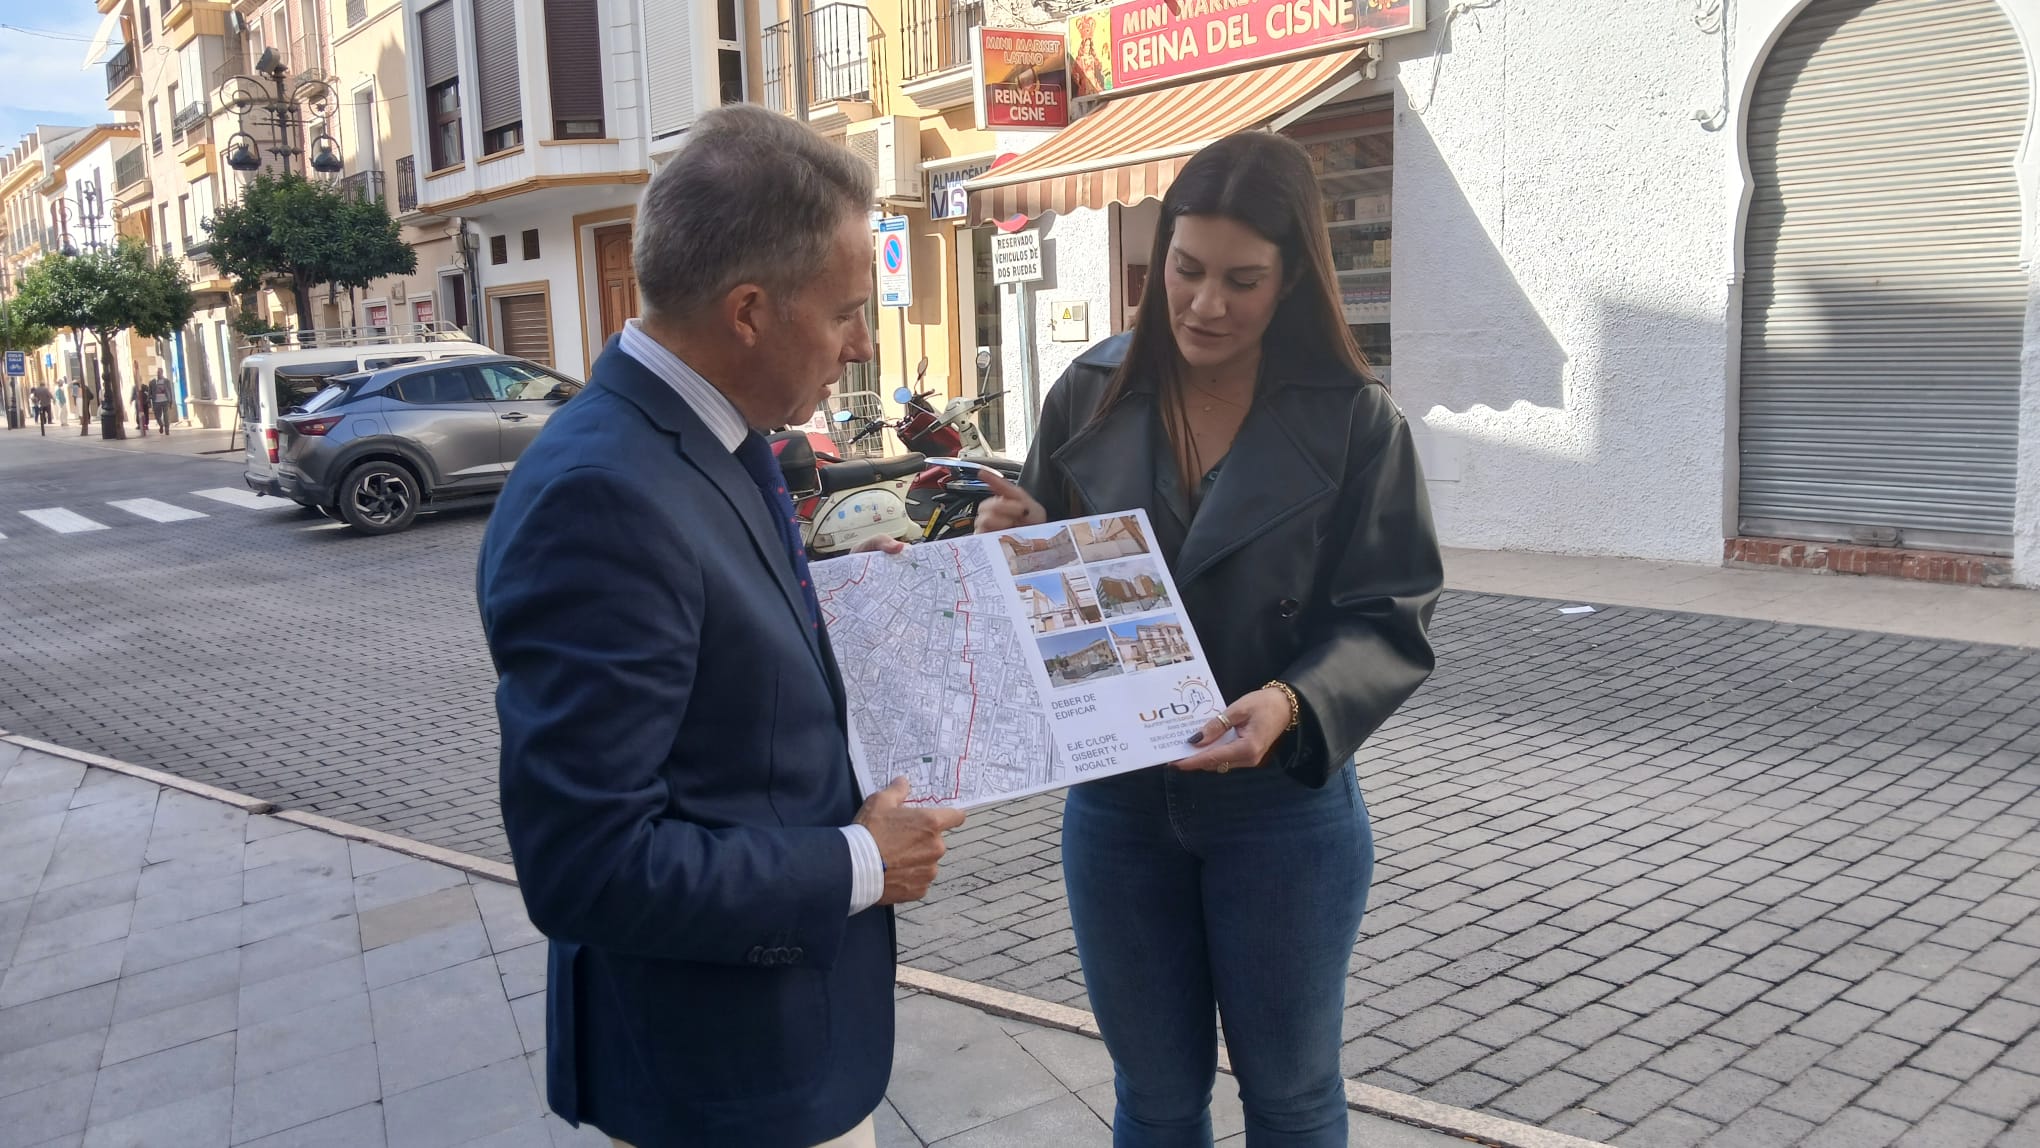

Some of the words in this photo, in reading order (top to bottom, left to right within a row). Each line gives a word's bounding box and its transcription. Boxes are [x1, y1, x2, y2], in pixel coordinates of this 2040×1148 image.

[1122, 3, 1168, 36] MINI
[985, 36, 1013, 51] MINI
[1016, 38, 1060, 53] MARKET
[1122, 26, 1199, 73] REINA
[1206, 13, 1258, 54] DEL
[1265, 0, 1354, 40] CISNE
[1003, 51, 1044, 66] LATINO
[994, 88, 1033, 105] REINA
[1035, 90, 1058, 106] DEL
[1009, 106, 1046, 121] CISNE
[997, 234, 1034, 250] RESERVADO
[994, 250, 1029, 265] VEHICULOS
[1029, 248, 1039, 260] DE
[997, 266, 1011, 279] DOS
[1012, 263, 1037, 277] RUEDAS
[1051, 696, 1082, 710] DEBER
[1083, 693, 1097, 703] DE
[1055, 704, 1097, 720] EDIFICAR
[1067, 740, 1084, 752] EJE
[1072, 746, 1109, 762] GISBERT
[1111, 744, 1118, 753] Y
[1075, 757, 1118, 774] NOGALTE
